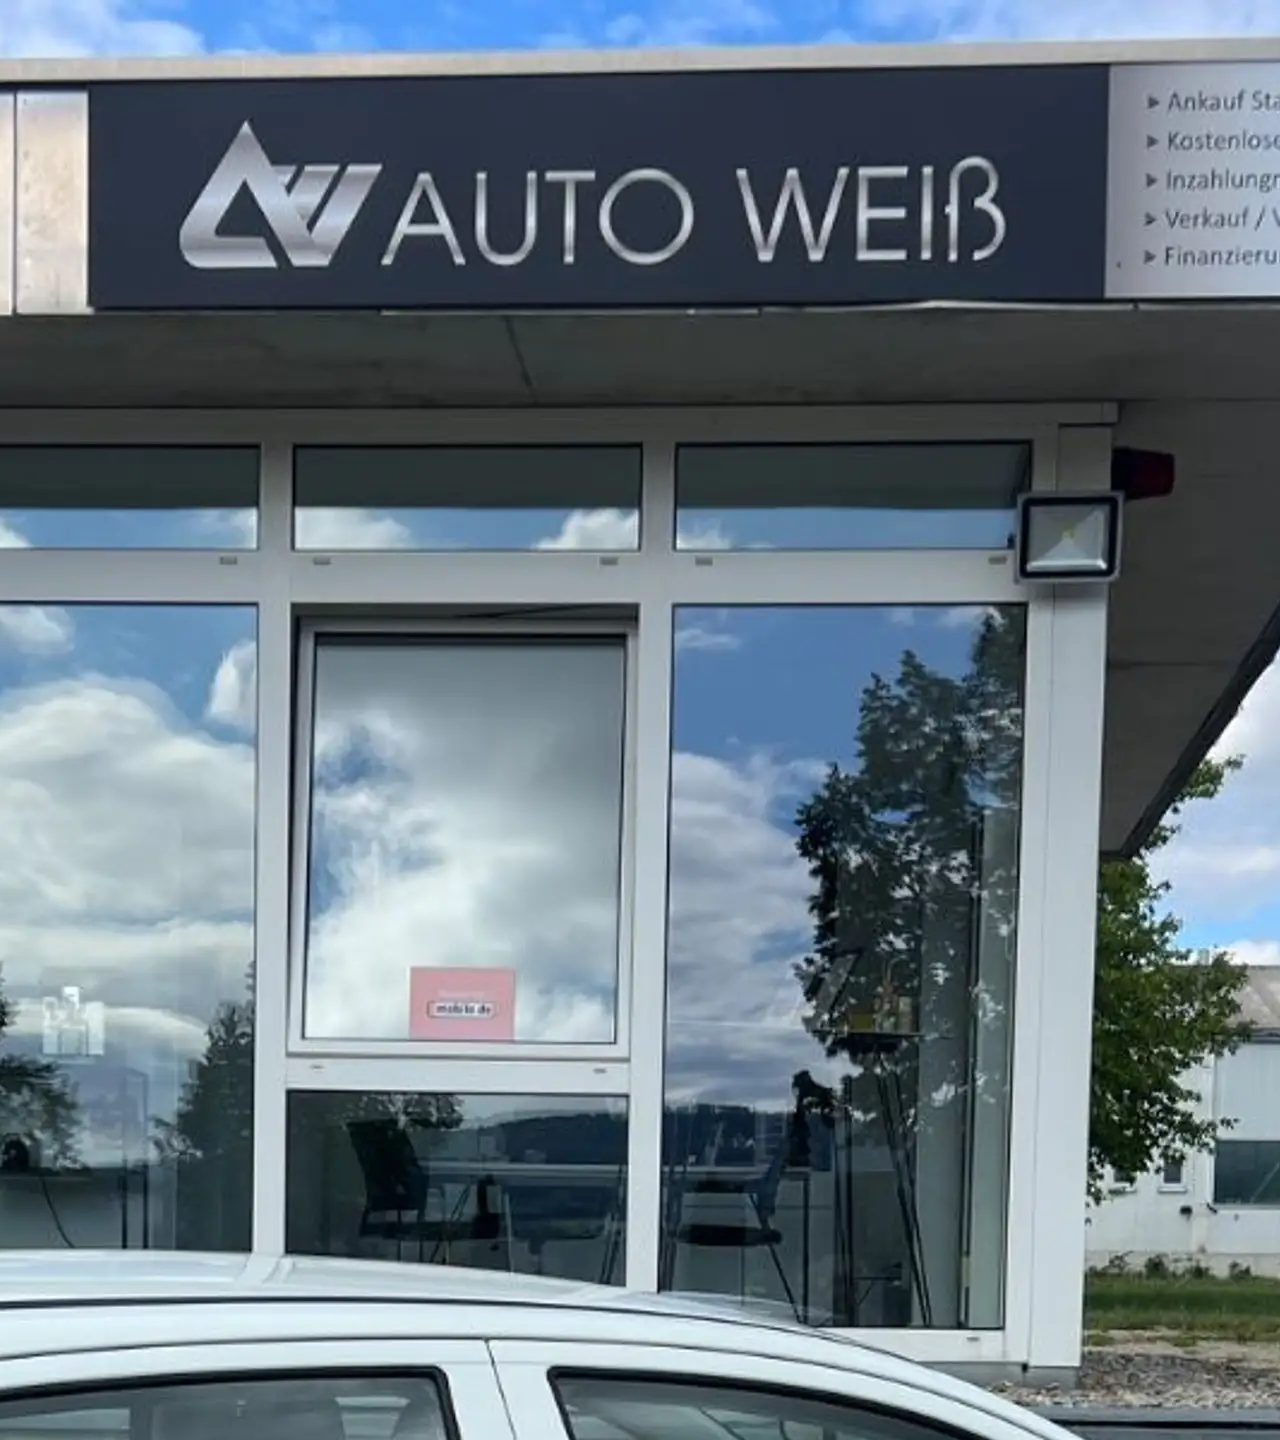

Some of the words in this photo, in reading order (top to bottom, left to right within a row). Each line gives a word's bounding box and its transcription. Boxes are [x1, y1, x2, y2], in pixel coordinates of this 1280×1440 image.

[1168, 88, 1246, 112] Ankauf
[381, 168, 694, 266] AUTO
[1165, 206, 1249, 230] Verkauf
